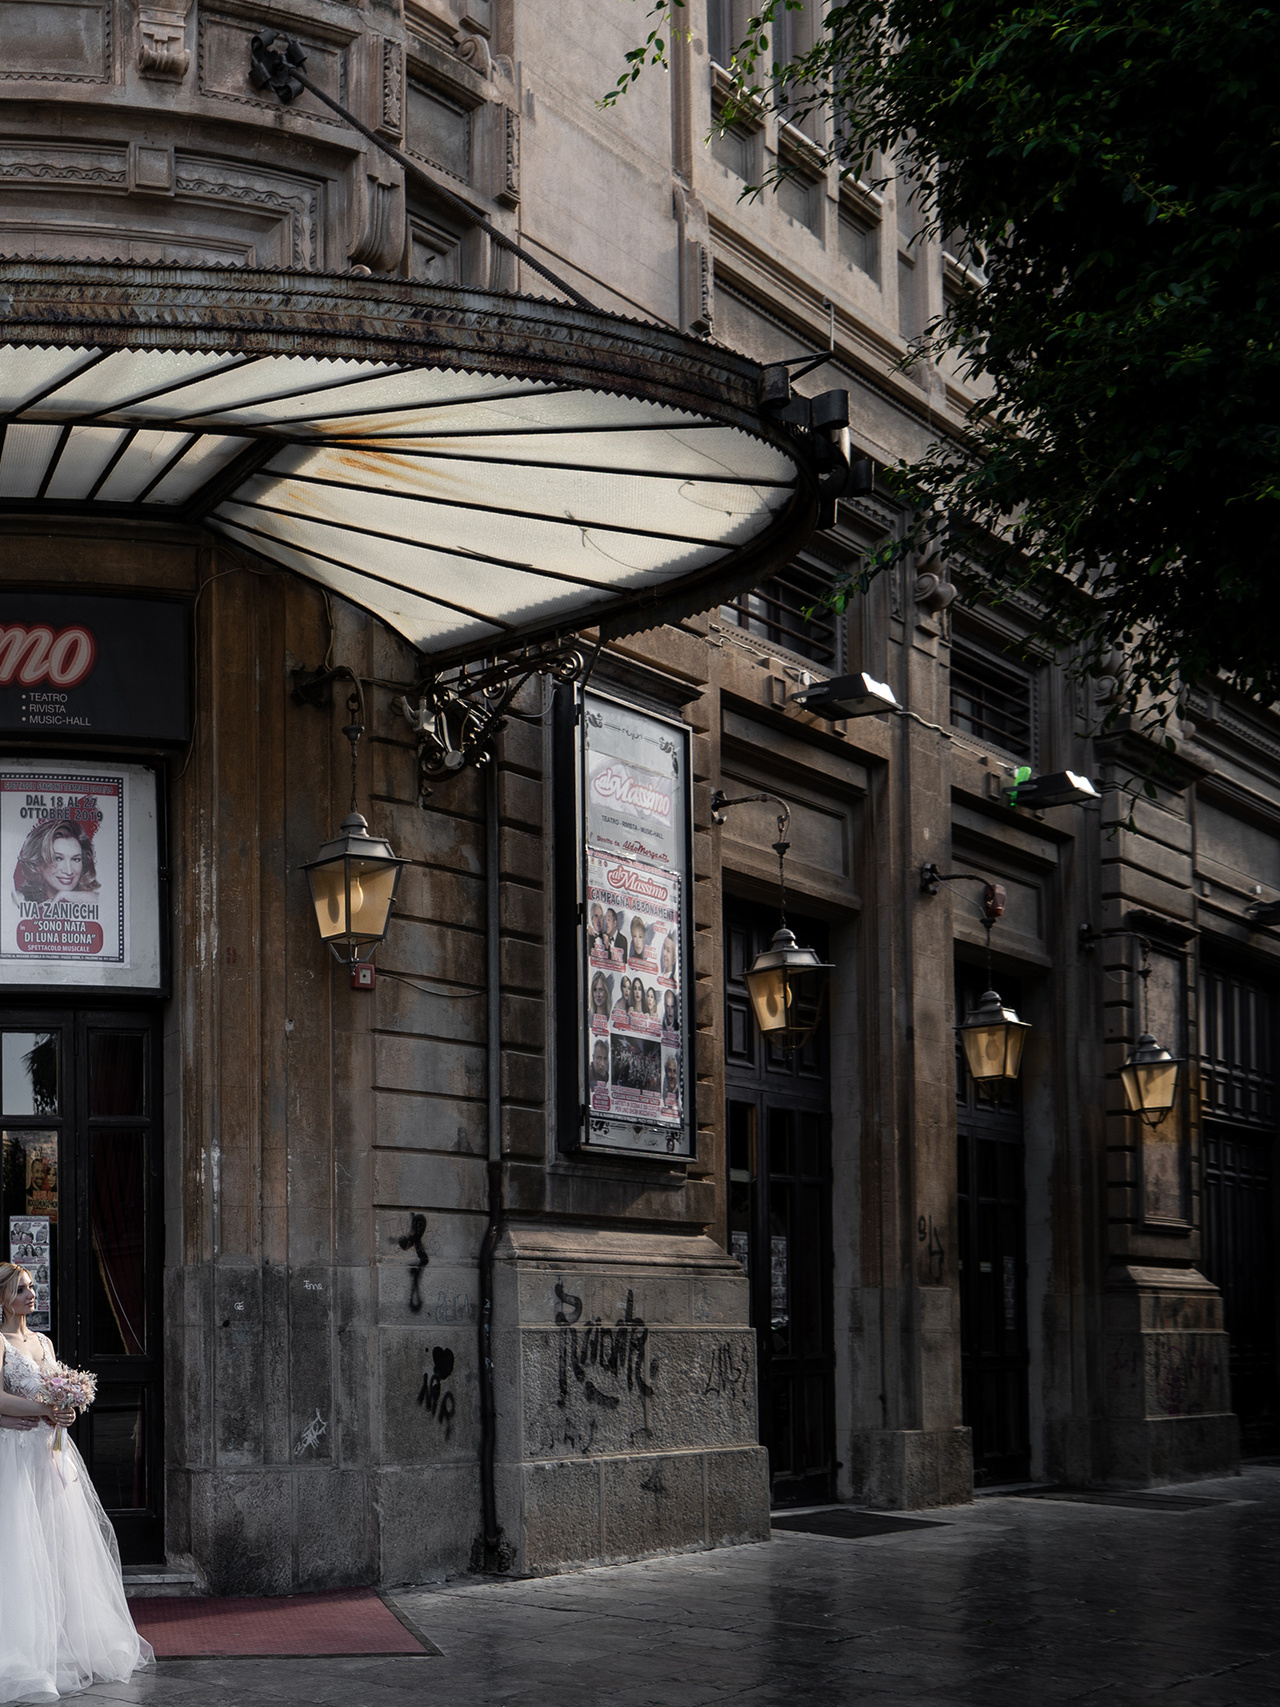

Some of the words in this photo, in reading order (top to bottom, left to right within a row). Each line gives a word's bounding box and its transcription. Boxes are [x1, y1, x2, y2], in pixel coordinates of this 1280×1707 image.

[28, 692, 68, 703] TEATRO
[28, 703, 67, 714] RIVISTA
[28, 715, 92, 726] MUSIC-HALL
[5, 782, 36, 790] SPETTACOLI
[37, 783, 63, 791] STAGIONE
[64, 784, 89, 792] TEATRALE
[90, 786, 113, 794] 2018/19
[26, 795, 46, 806] DAL
[51, 796, 63, 807] 18
[67, 797, 80, 808] AL
[84, 798, 97, 809] 27
[19, 807, 70, 819] OTTOBRE
[75, 809, 103, 821] 2019
[601, 815, 620, 826] TEATRO
[597, 835, 613, 846] Diretto
[591, 889, 631, 908] CAMPAGNA
[20, 902, 39, 918] IVA
[42, 903, 99, 920] ZANICCHI
[64, 922, 86, 932] NATA
[24, 932, 34, 943] DI
[36, 932, 60, 944] LUNA
[62, 945, 90, 953] MUSICALE
